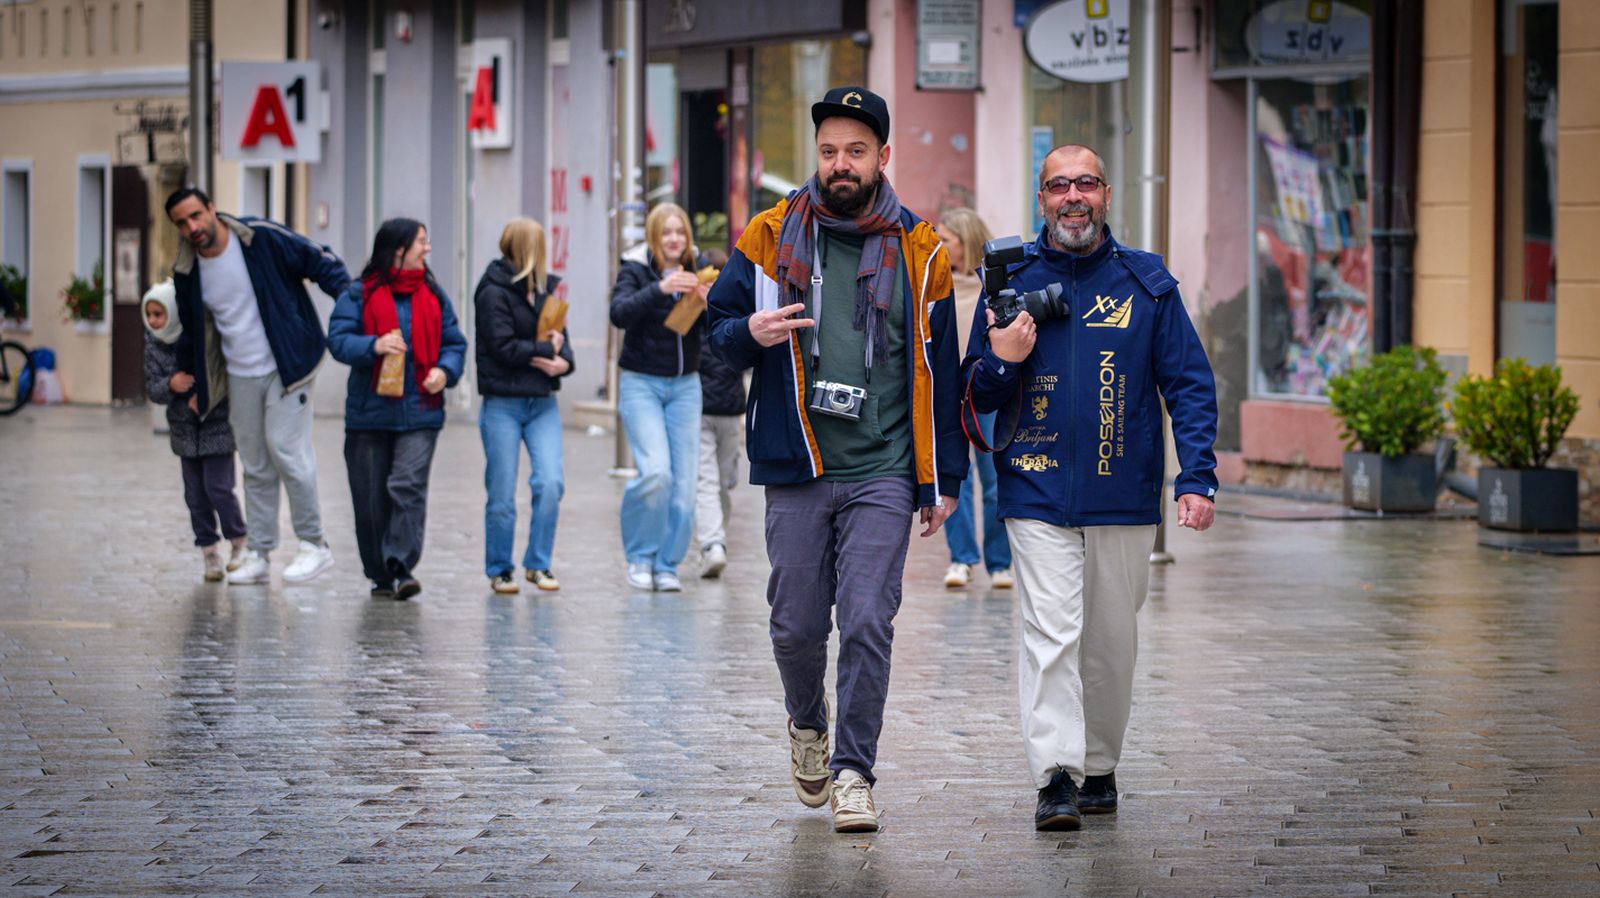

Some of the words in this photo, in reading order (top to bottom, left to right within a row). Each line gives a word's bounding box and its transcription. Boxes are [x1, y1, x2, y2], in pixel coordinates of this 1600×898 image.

[240, 75, 306, 150] A1
[1118, 374, 1126, 398] TEAM
[1098, 351, 1115, 475] POSEIDON
[1117, 400, 1125, 434] SAILING
[1011, 458, 1059, 468] THERAPIA
[1116, 444, 1124, 457] SKI
